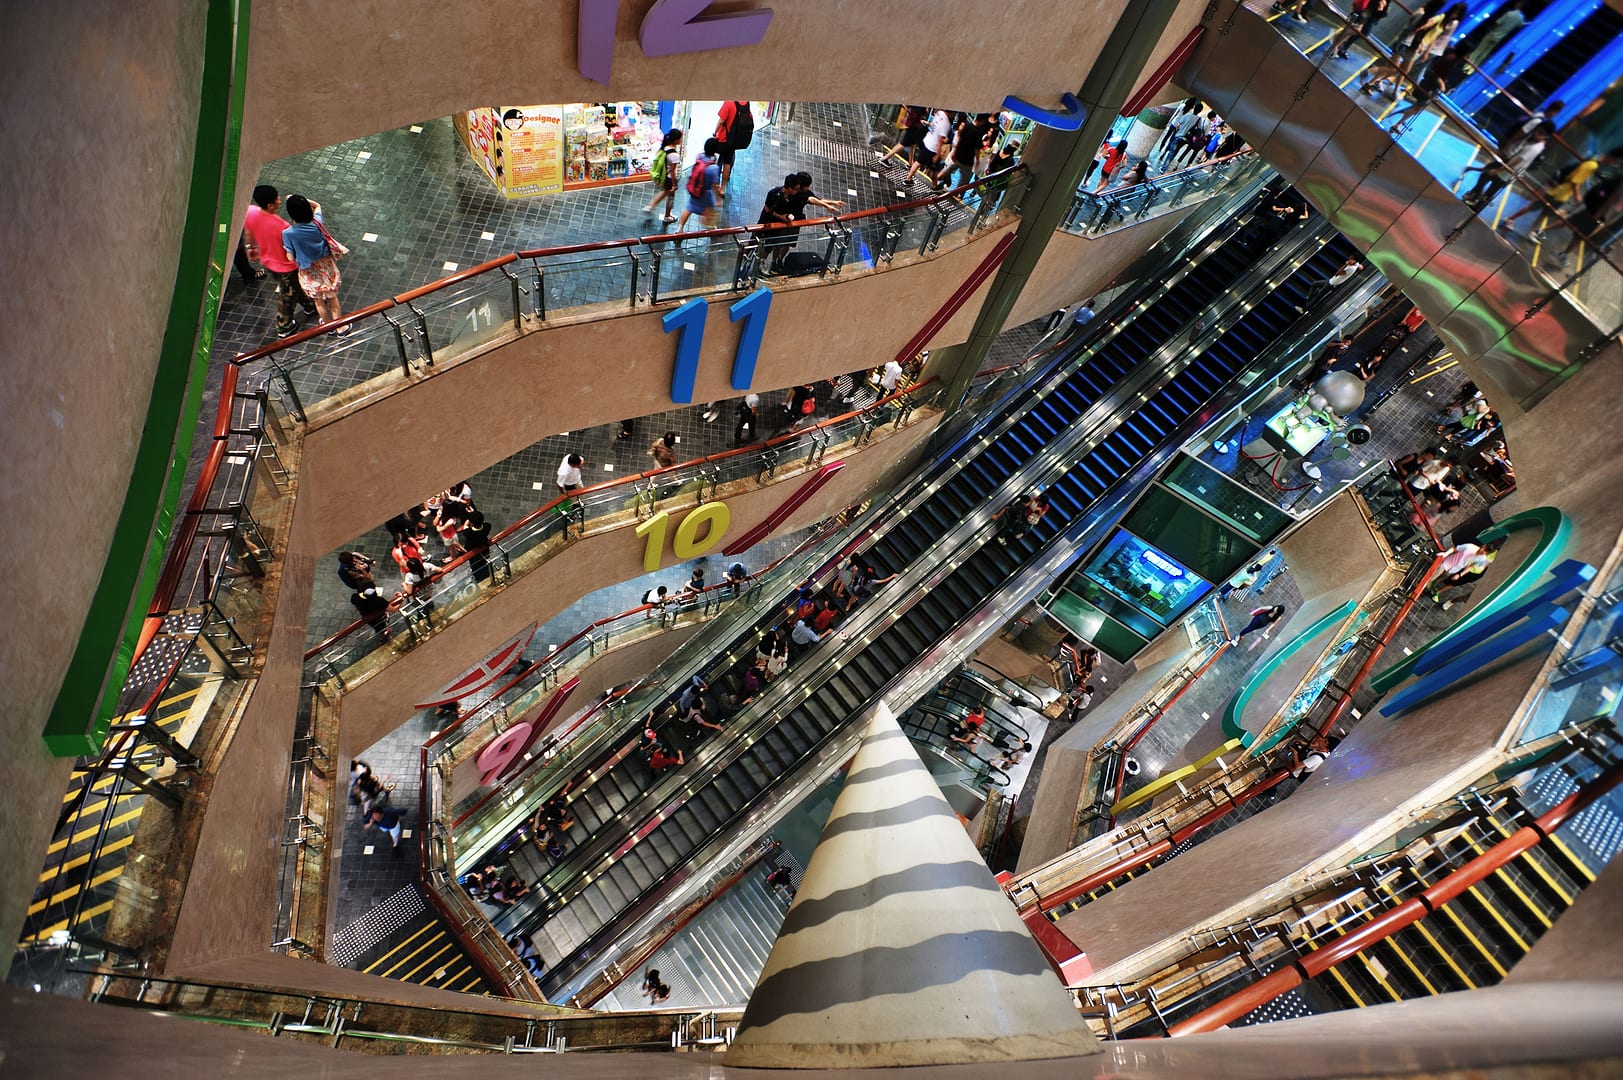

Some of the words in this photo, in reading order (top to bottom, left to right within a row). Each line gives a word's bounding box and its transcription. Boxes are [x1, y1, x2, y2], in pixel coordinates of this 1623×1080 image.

[466, 302, 491, 332] 11
[663, 287, 773, 404] 11
[635, 501, 731, 572] 10
[477, 722, 533, 786] 9
